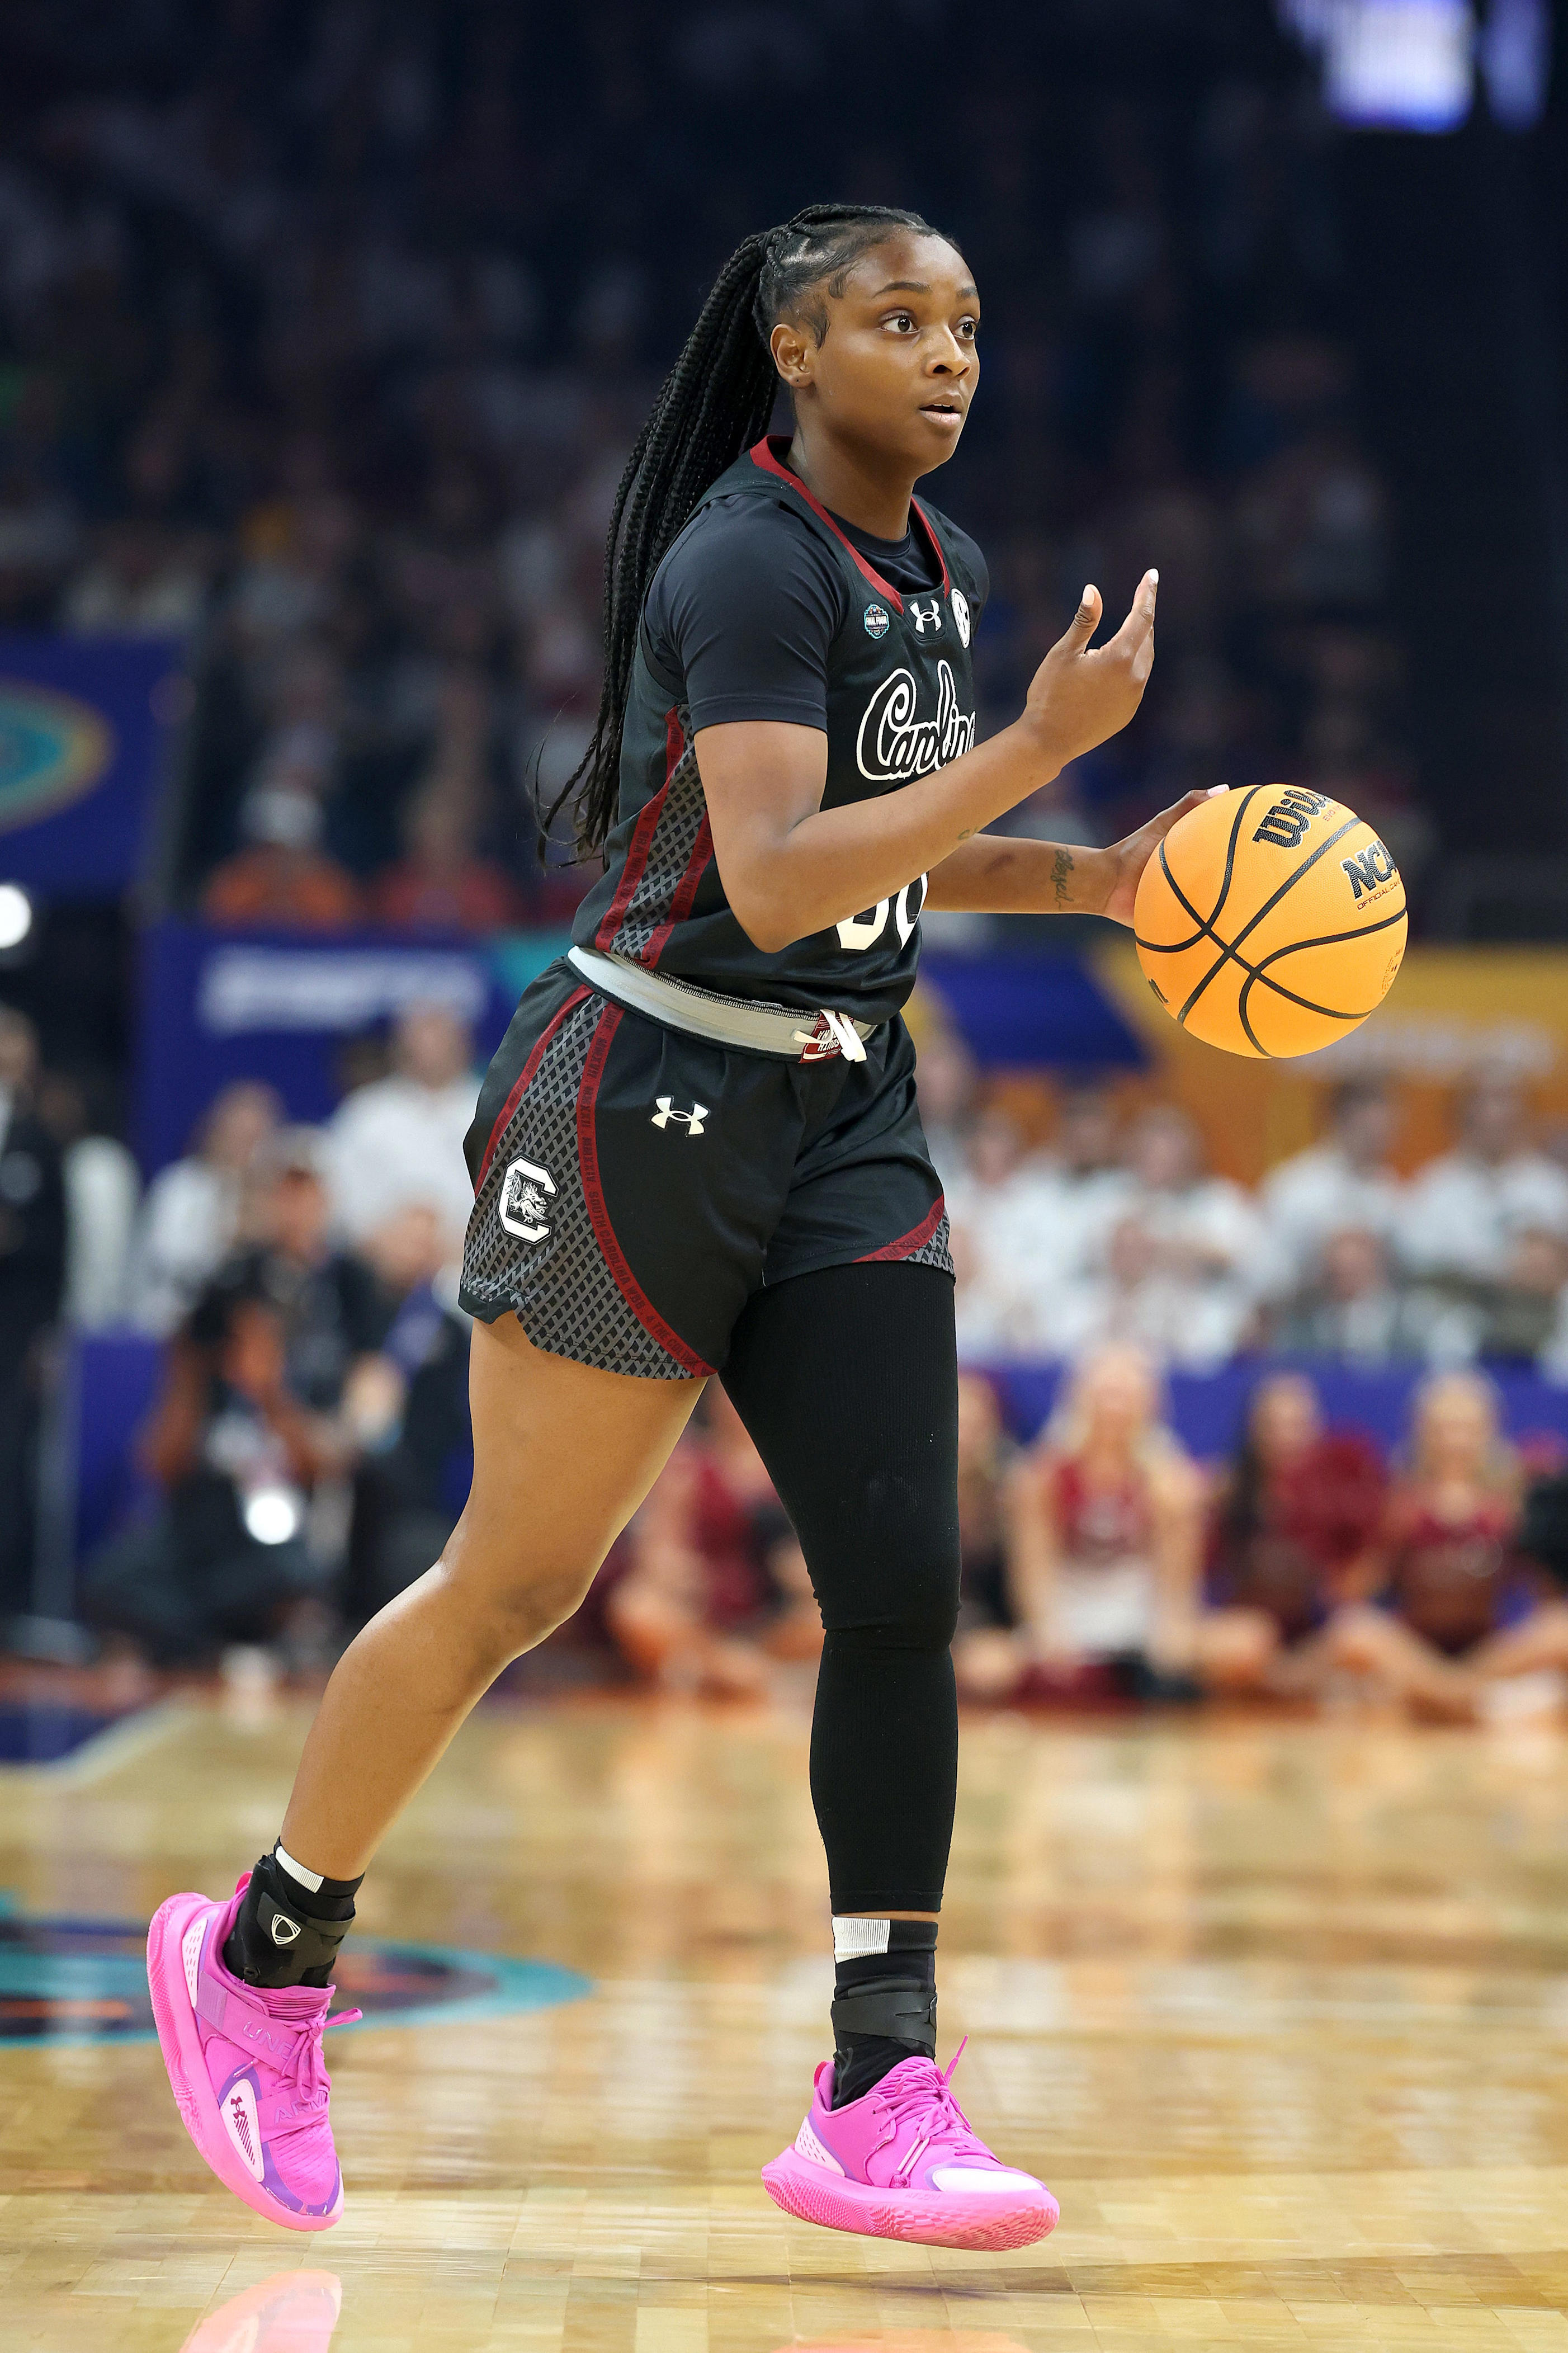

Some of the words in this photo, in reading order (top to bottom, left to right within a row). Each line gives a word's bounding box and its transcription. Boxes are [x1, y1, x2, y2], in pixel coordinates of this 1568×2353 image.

[857, 659, 975, 781] Carolin
[1252, 790, 1333, 848] Wils
[1357, 888, 1390, 910] OFFICIAL
[589, 1191, 607, 1228] SOUTH
[599, 1230, 631, 1285] CAROLINA
[625, 1285, 646, 1310] WBB
[243, 2020, 295, 2060] UND
[274, 2092, 326, 2124] ARM
